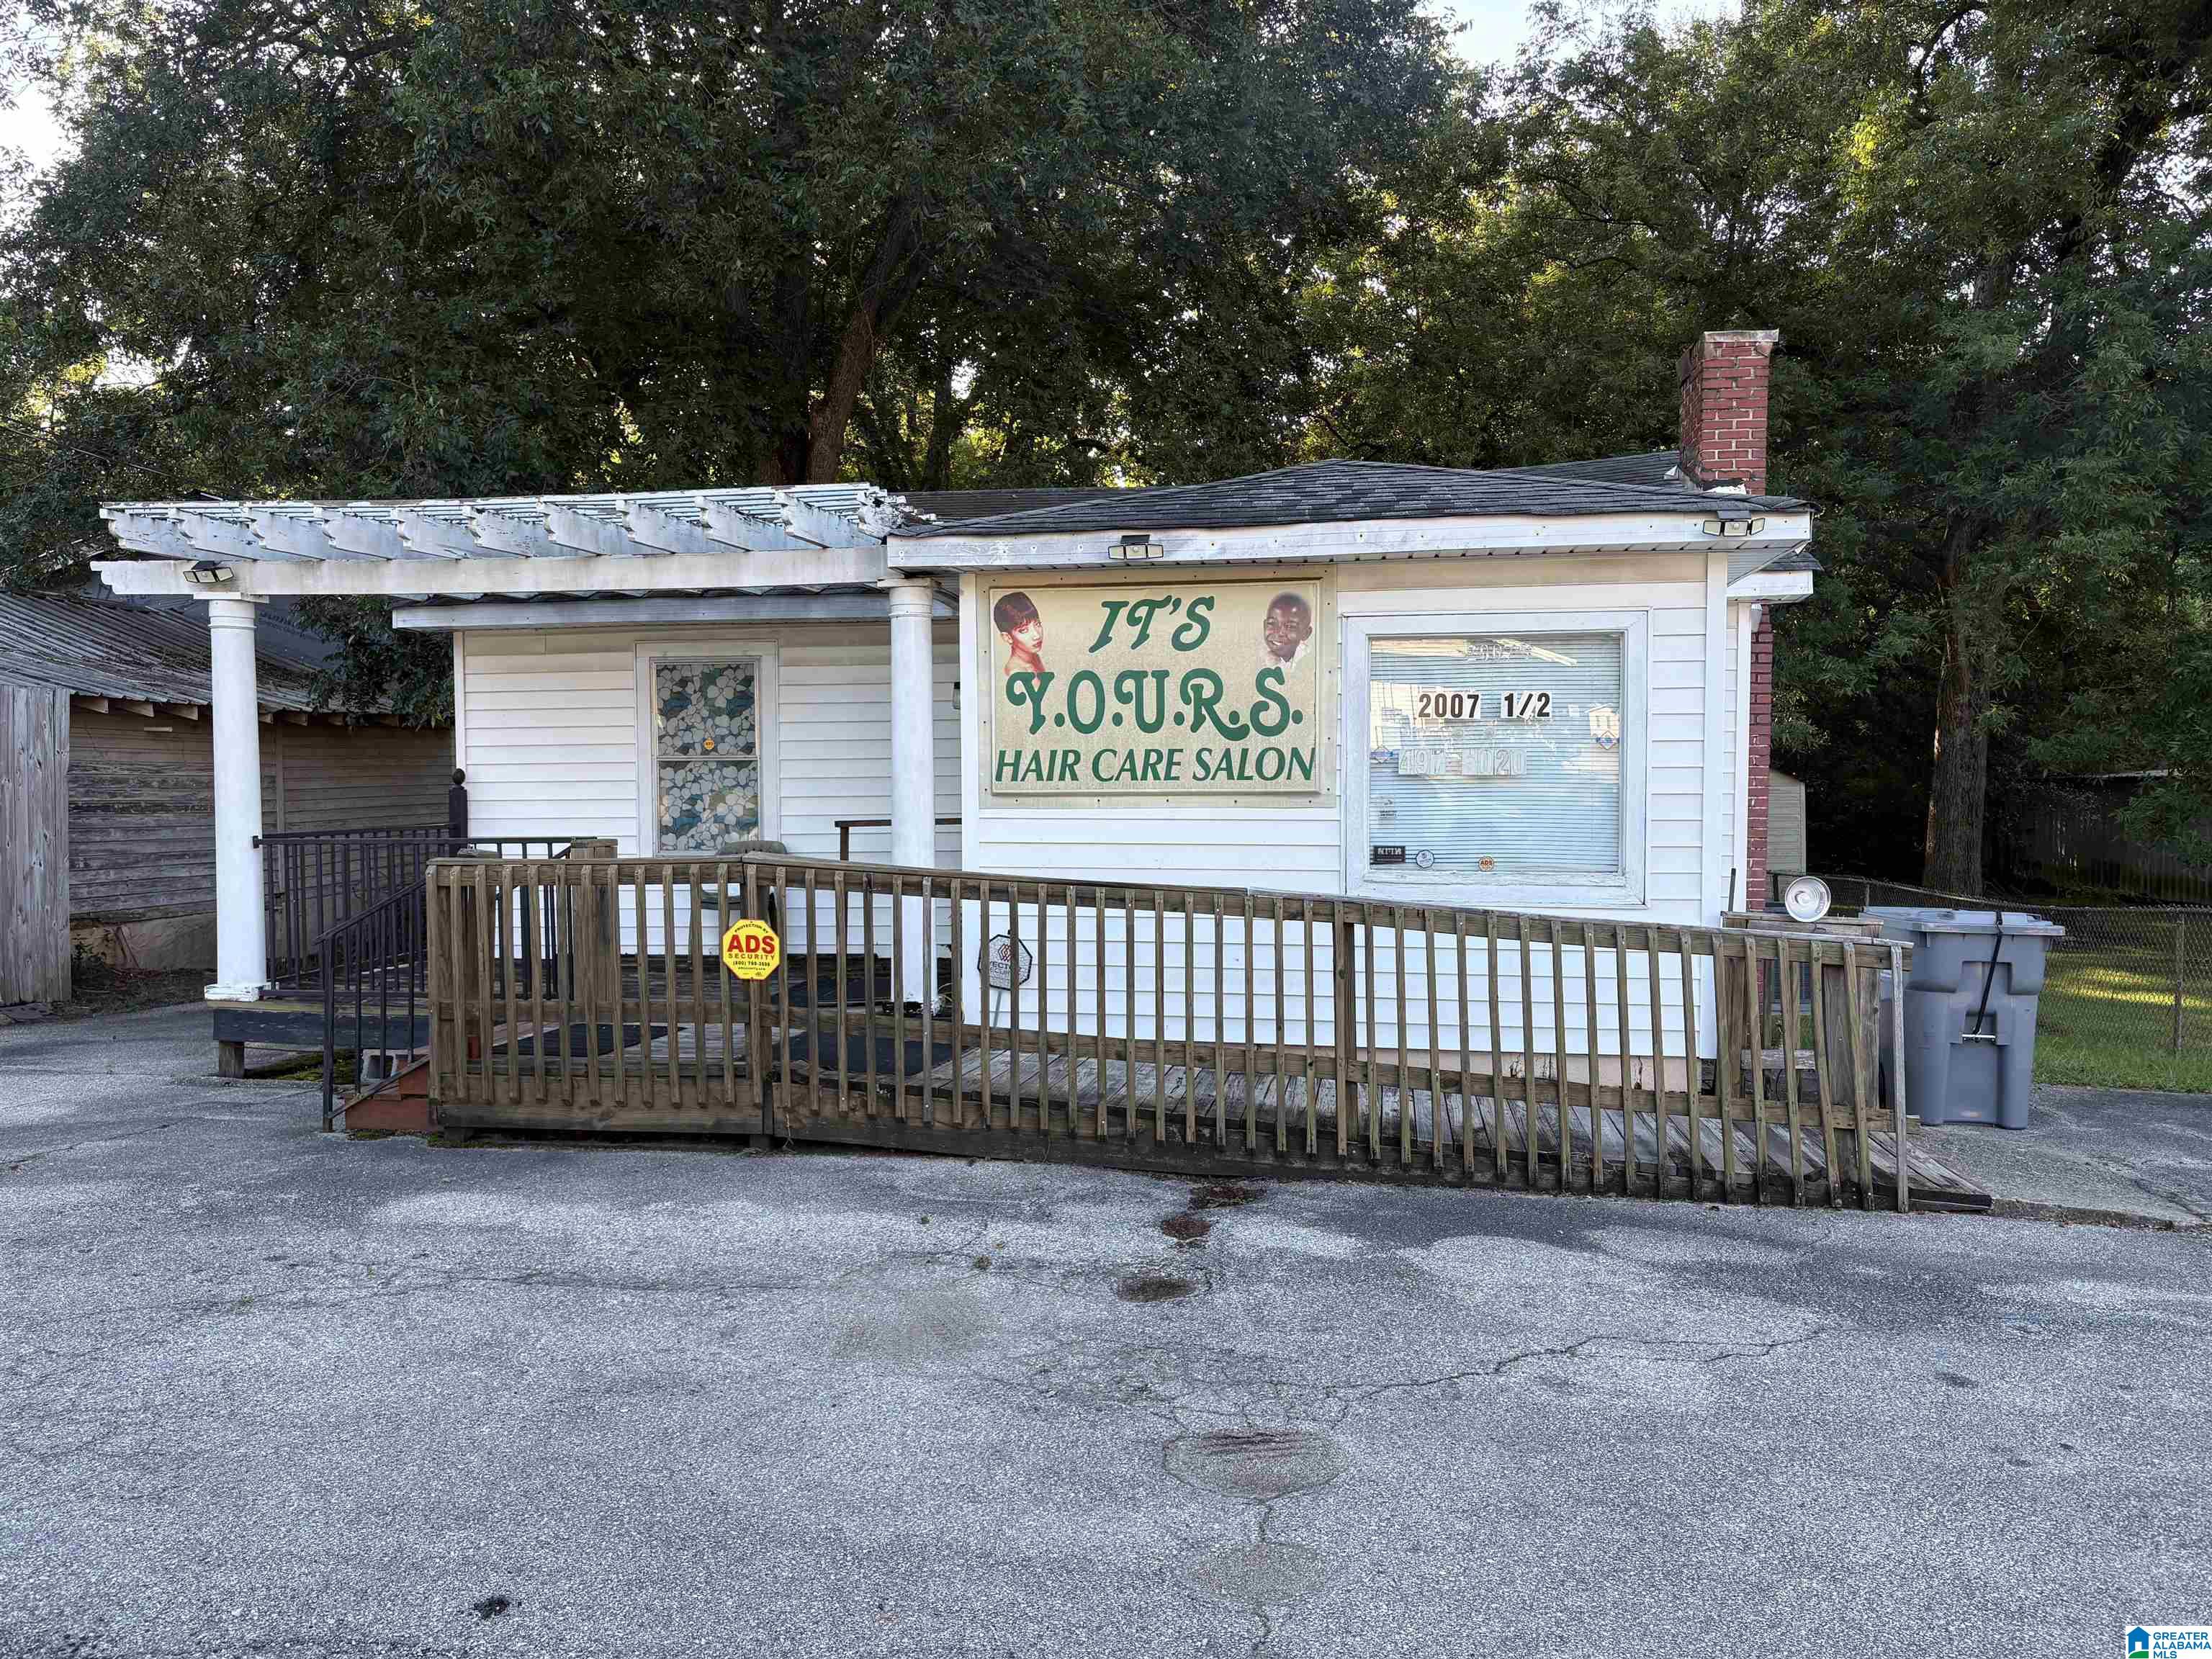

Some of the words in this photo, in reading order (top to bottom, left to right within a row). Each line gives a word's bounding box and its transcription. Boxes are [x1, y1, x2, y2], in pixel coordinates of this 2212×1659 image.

[1088, 595, 1215, 653] IT'S
[1005, 666, 1303, 741] Y.O.U.R.S.
[1419, 693, 1479, 718] 2007
[1504, 693, 1550, 717] 1/2
[995, 748, 1080, 782] HAIR
[1092, 748, 1184, 782] CARE
[1192, 747, 1316, 781] SALON
[727, 934, 775, 954] ADS
